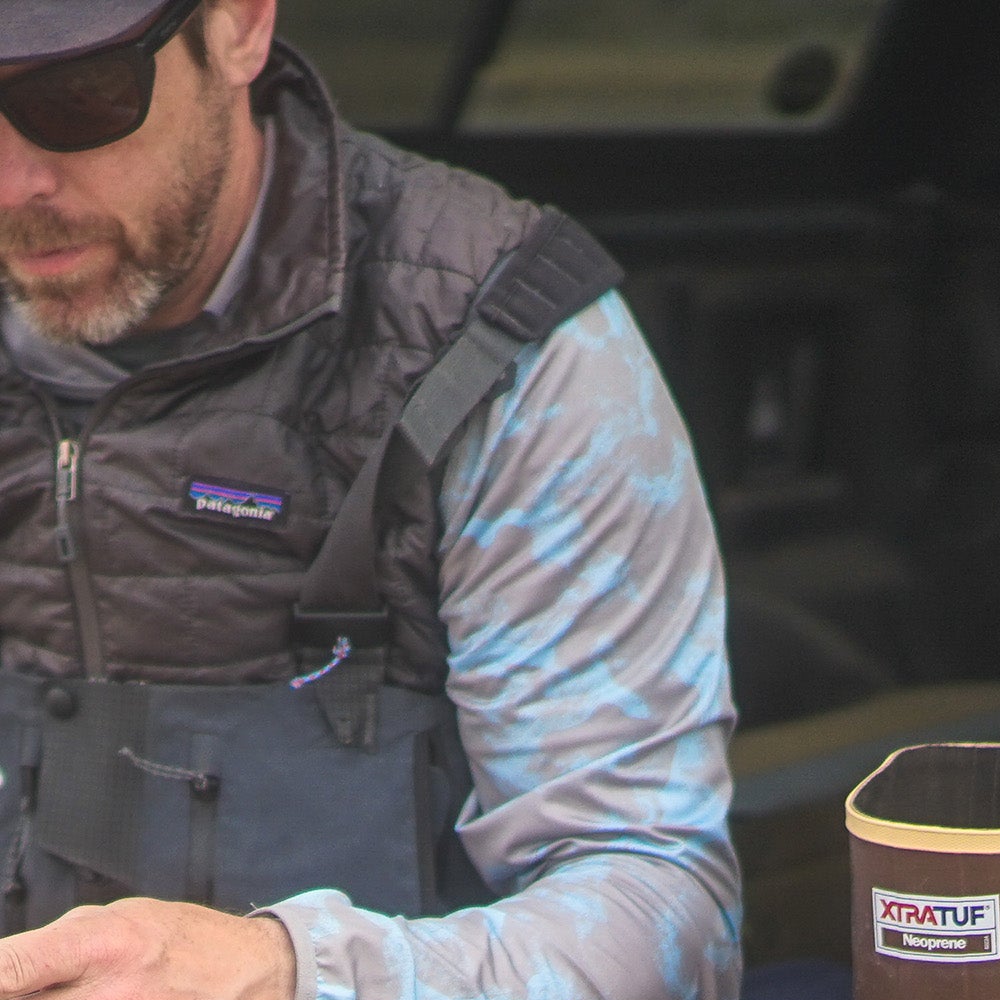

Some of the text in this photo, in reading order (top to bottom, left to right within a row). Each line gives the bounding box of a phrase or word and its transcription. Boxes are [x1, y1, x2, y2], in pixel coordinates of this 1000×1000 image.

[196, 498, 275, 520] patagonia
[880, 899, 986, 926] XTRATUF
[902, 933, 967, 951] Neoprene
